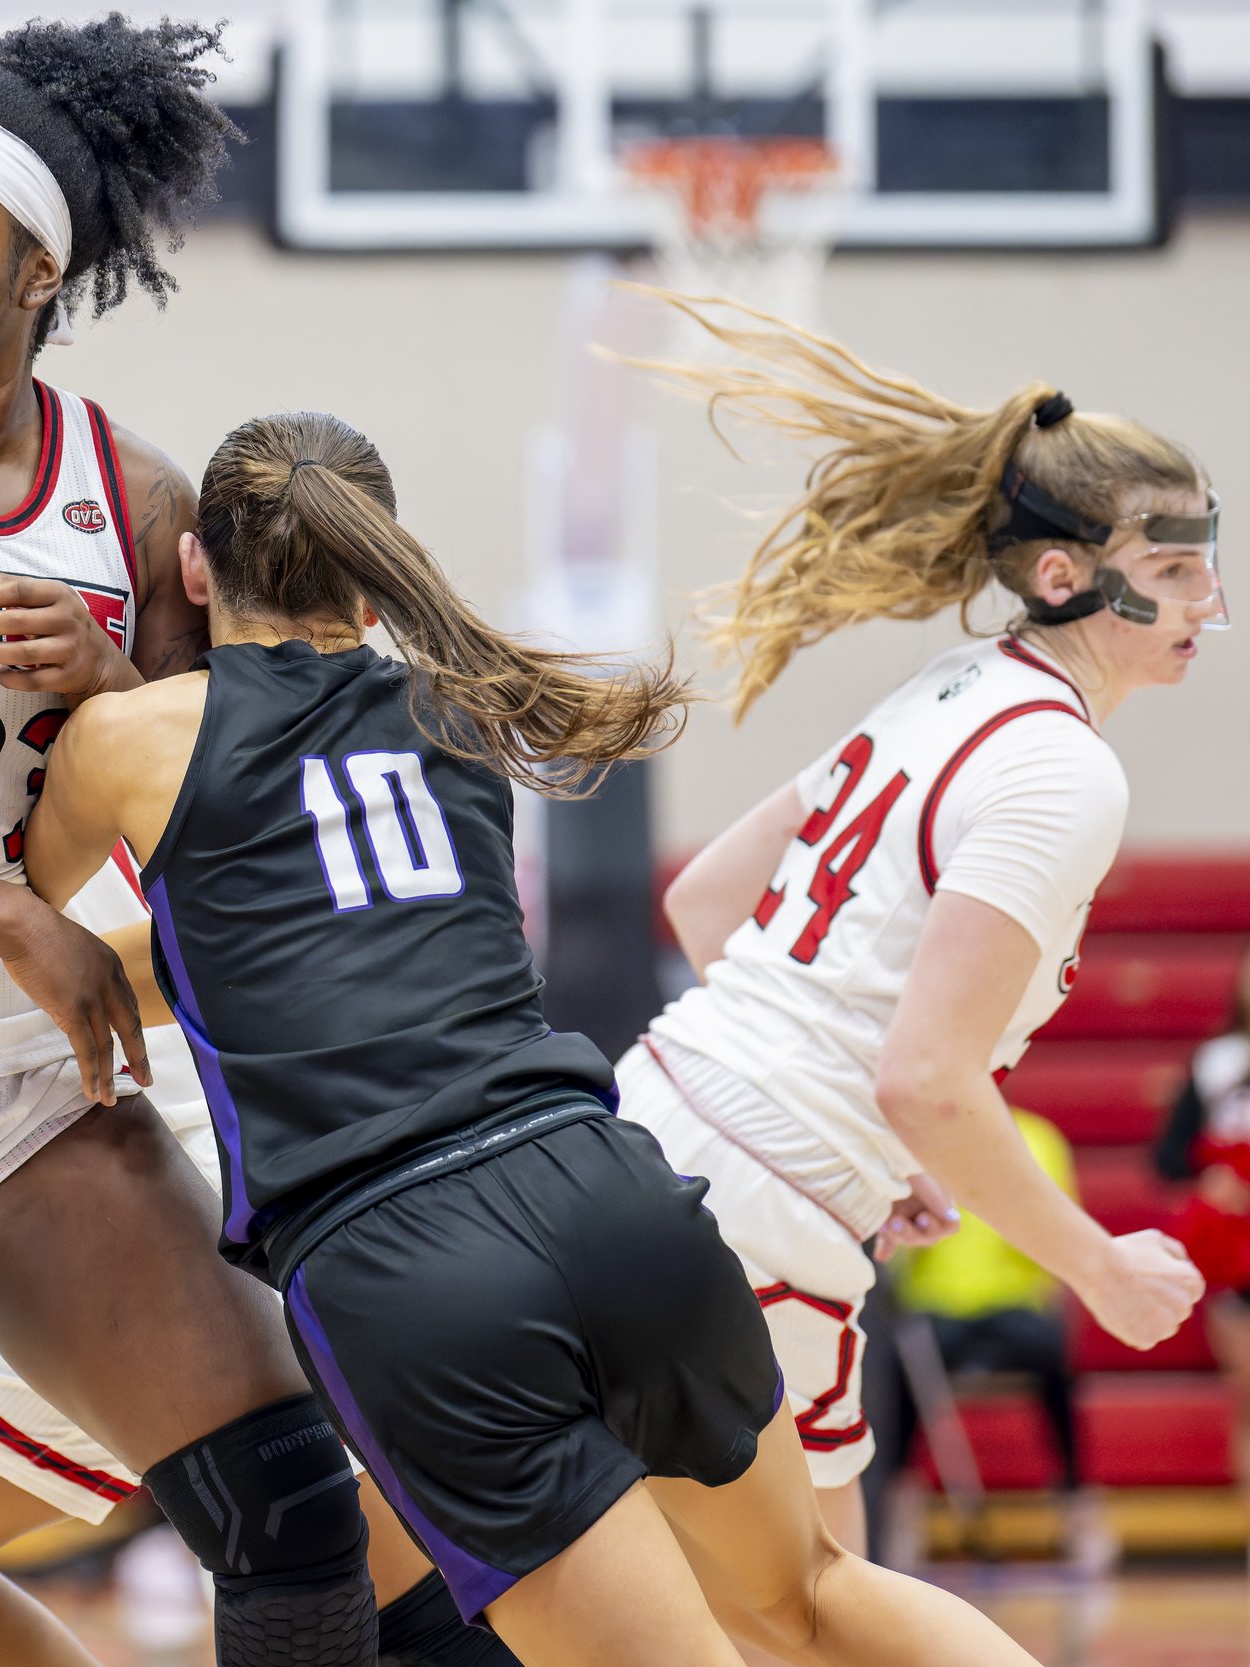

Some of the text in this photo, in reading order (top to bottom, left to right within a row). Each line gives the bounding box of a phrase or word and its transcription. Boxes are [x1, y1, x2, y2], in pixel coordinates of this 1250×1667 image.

[70, 509, 102, 525] OVC
[300, 749, 466, 914] 10
[752, 733, 910, 965] 24
